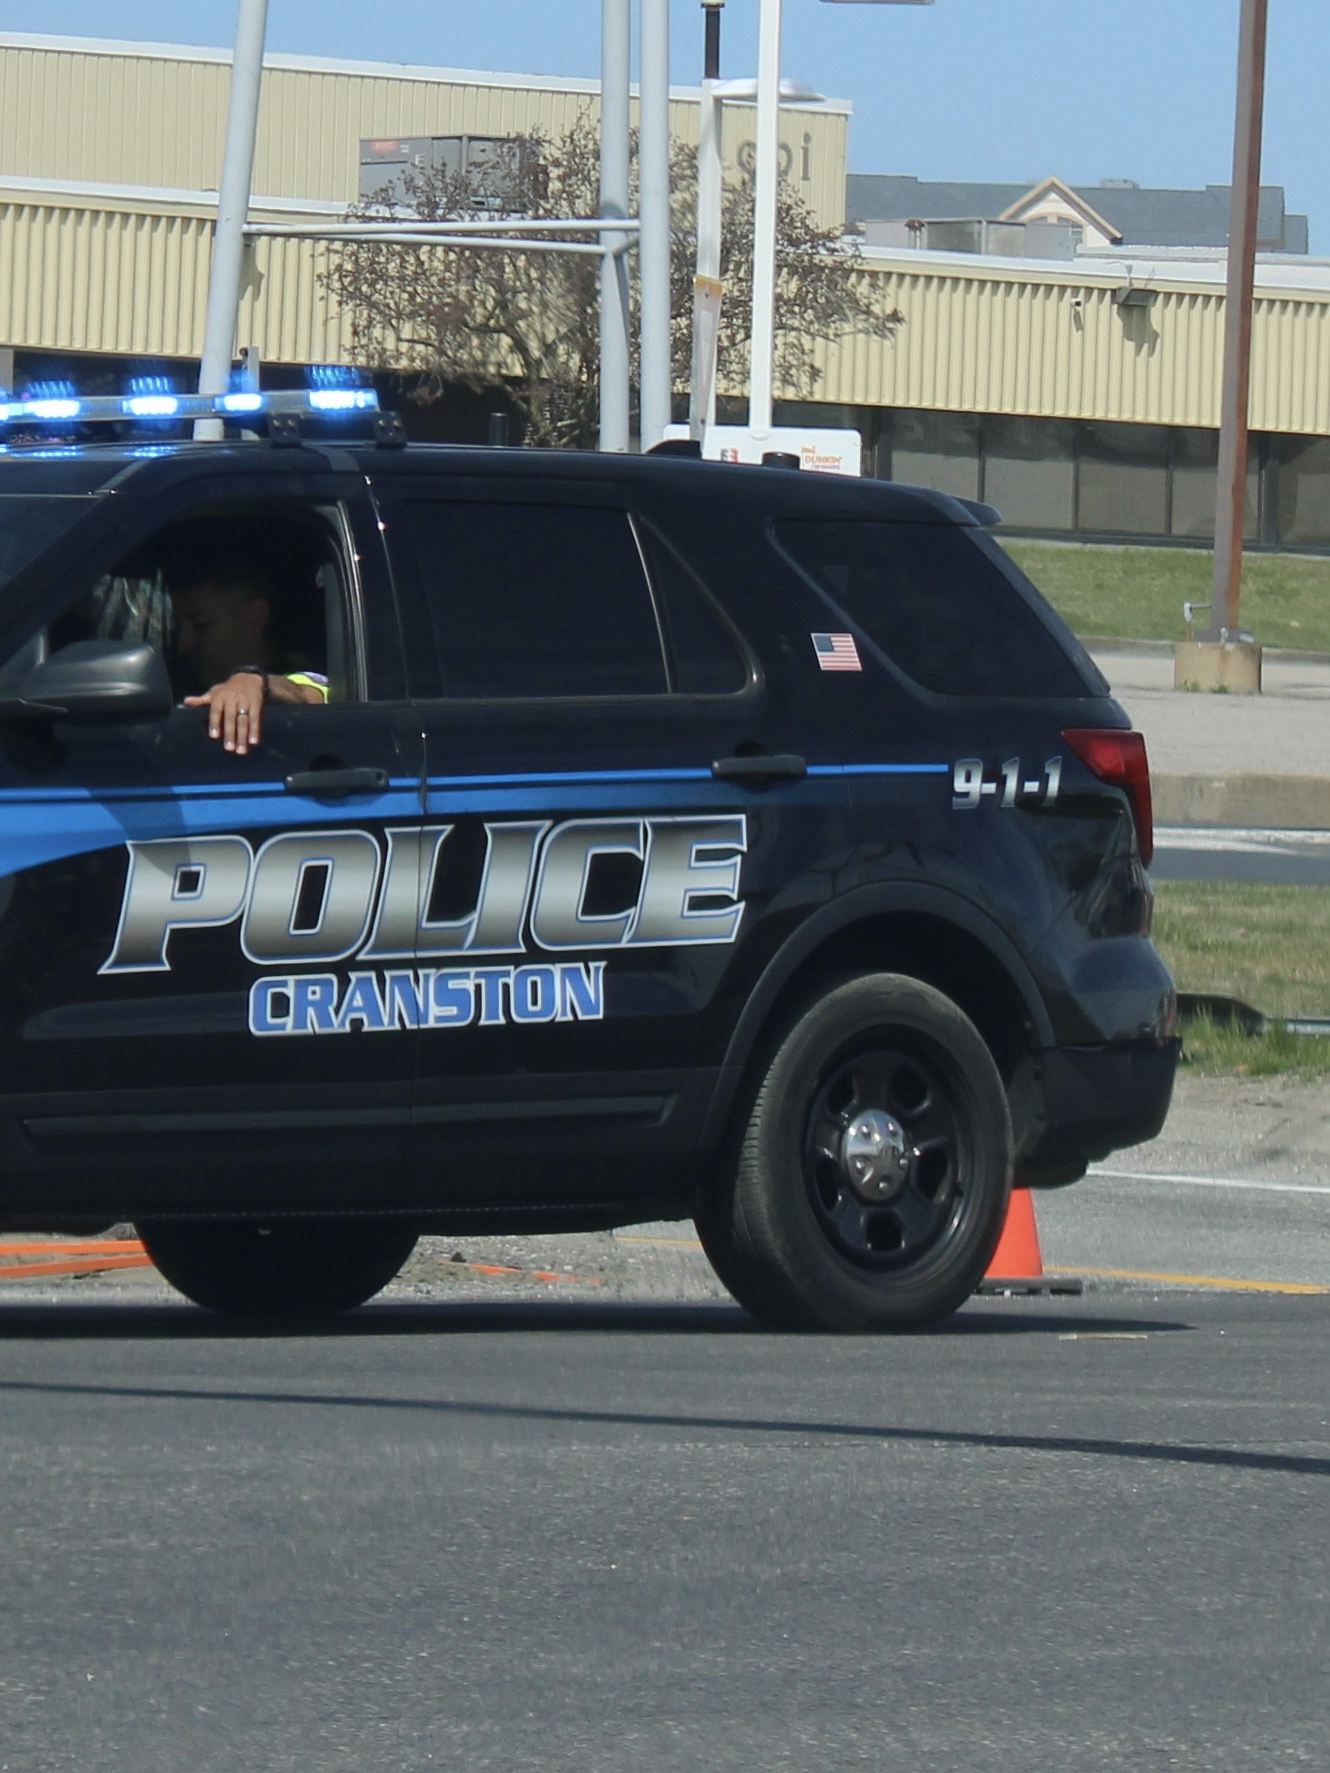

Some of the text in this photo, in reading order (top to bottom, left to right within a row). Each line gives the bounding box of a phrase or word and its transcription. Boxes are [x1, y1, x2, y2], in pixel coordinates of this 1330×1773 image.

[952, 755, 1062, 810] 9-1-1
[97, 814, 748, 974] POLICE
[248, 961, 607, 1036] CRANSTON
